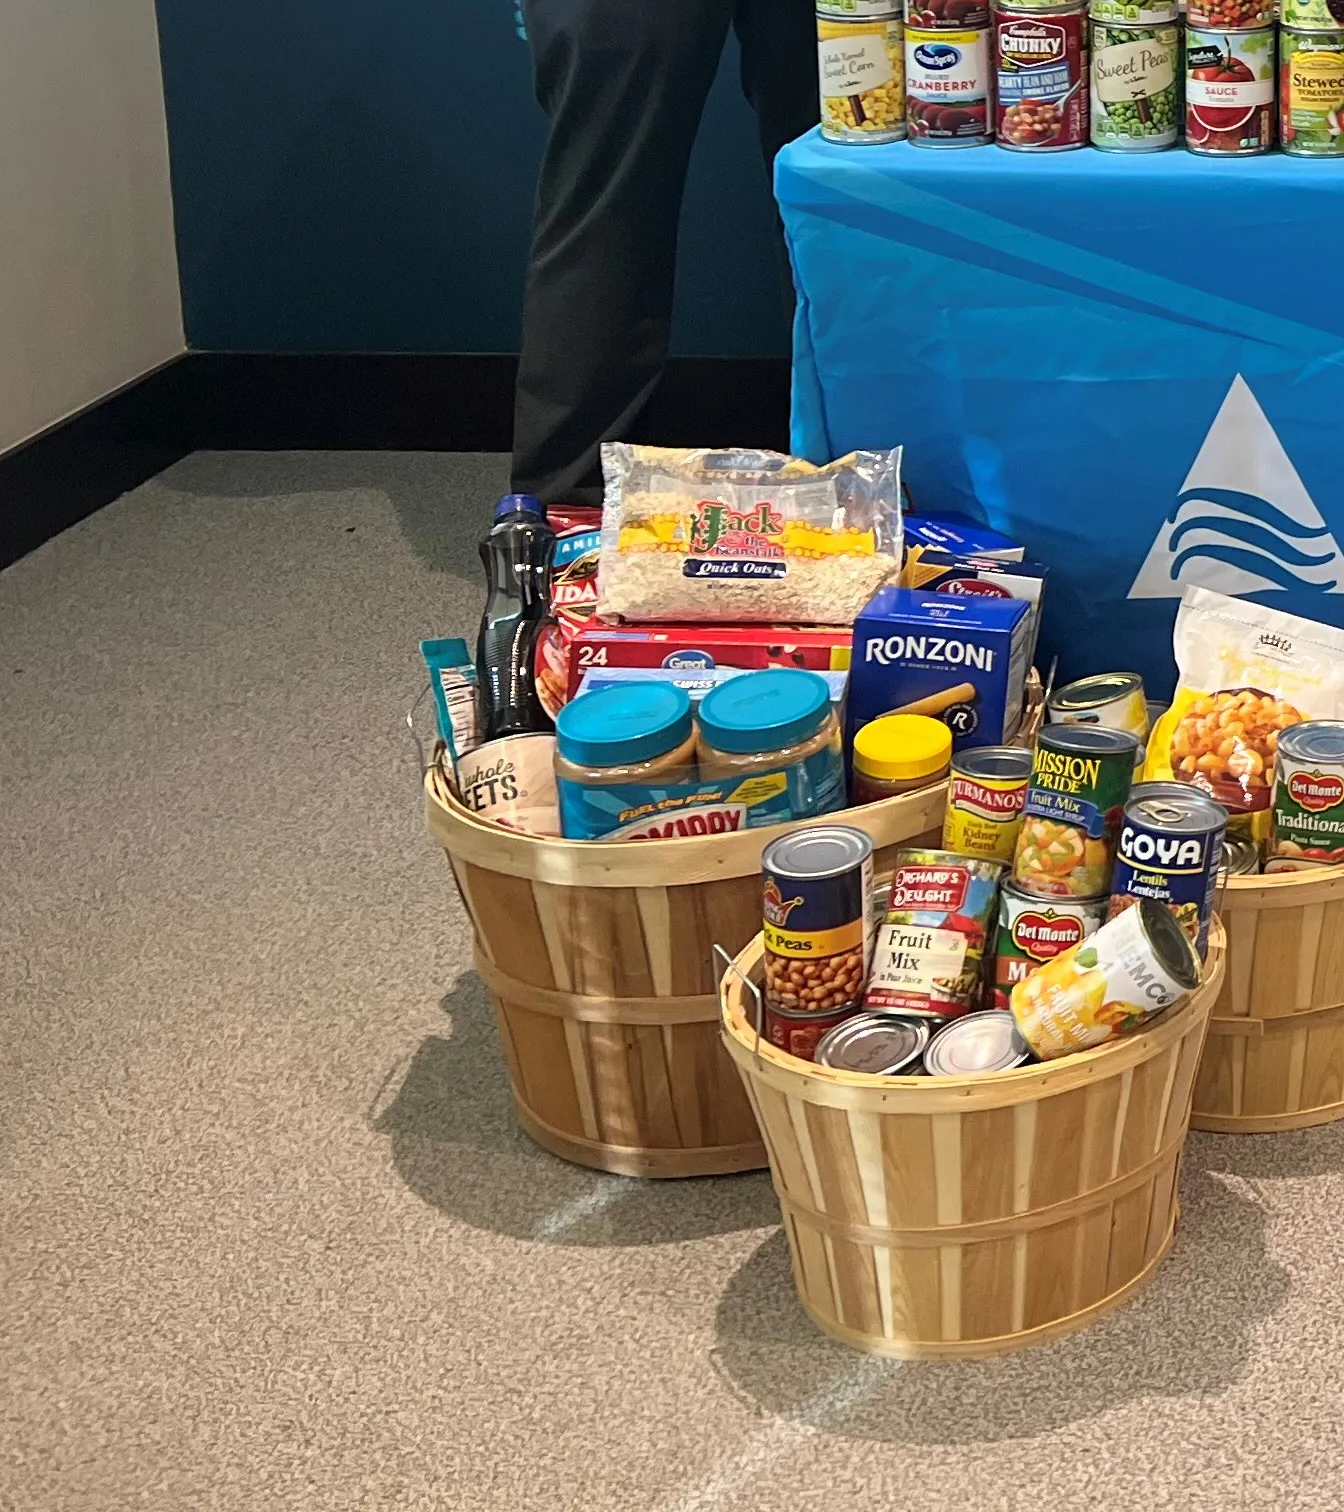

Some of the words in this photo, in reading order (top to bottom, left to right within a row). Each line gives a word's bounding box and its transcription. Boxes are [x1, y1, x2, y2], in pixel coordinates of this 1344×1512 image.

[1000, 33, 1062, 55] CHUNKY
[1096, 58, 1137, 81] Sweet
[1139, 49, 1170, 73] Peas
[907, 79, 978, 92] CRANBERRY
[1204, 86, 1238, 96] SAUCE
[693, 500, 779, 555] Jack
[696, 562, 739, 576] Quick
[742, 562, 774, 574] Oats
[578, 646, 609, 666] 24
[865, 636, 997, 673] RONZONI
[952, 710, 968, 728] R
[1033, 745, 1102, 791] MISSION
[1036, 772, 1082, 795] PRIDE
[1291, 779, 1308, 794] Del
[1308, 780, 1343, 798] Monte
[1055, 797, 1081, 815] Mix
[962, 825, 1000, 841] Kidney
[964, 837, 997, 851] Beans
[1120, 825, 1201, 865] GOYA
[895, 869, 960, 888] ORCHARD'S
[1132, 869, 1169, 887] Lentils
[894, 887, 953, 906] DELIGHT
[1126, 880, 1171, 901] Lentejas
[888, 929, 933, 950] Fruit
[1016, 920, 1037, 939] Del
[1037, 925, 1080, 943] Monte
[775, 935, 814, 951] Peas
[886, 951, 921, 971] Mix
